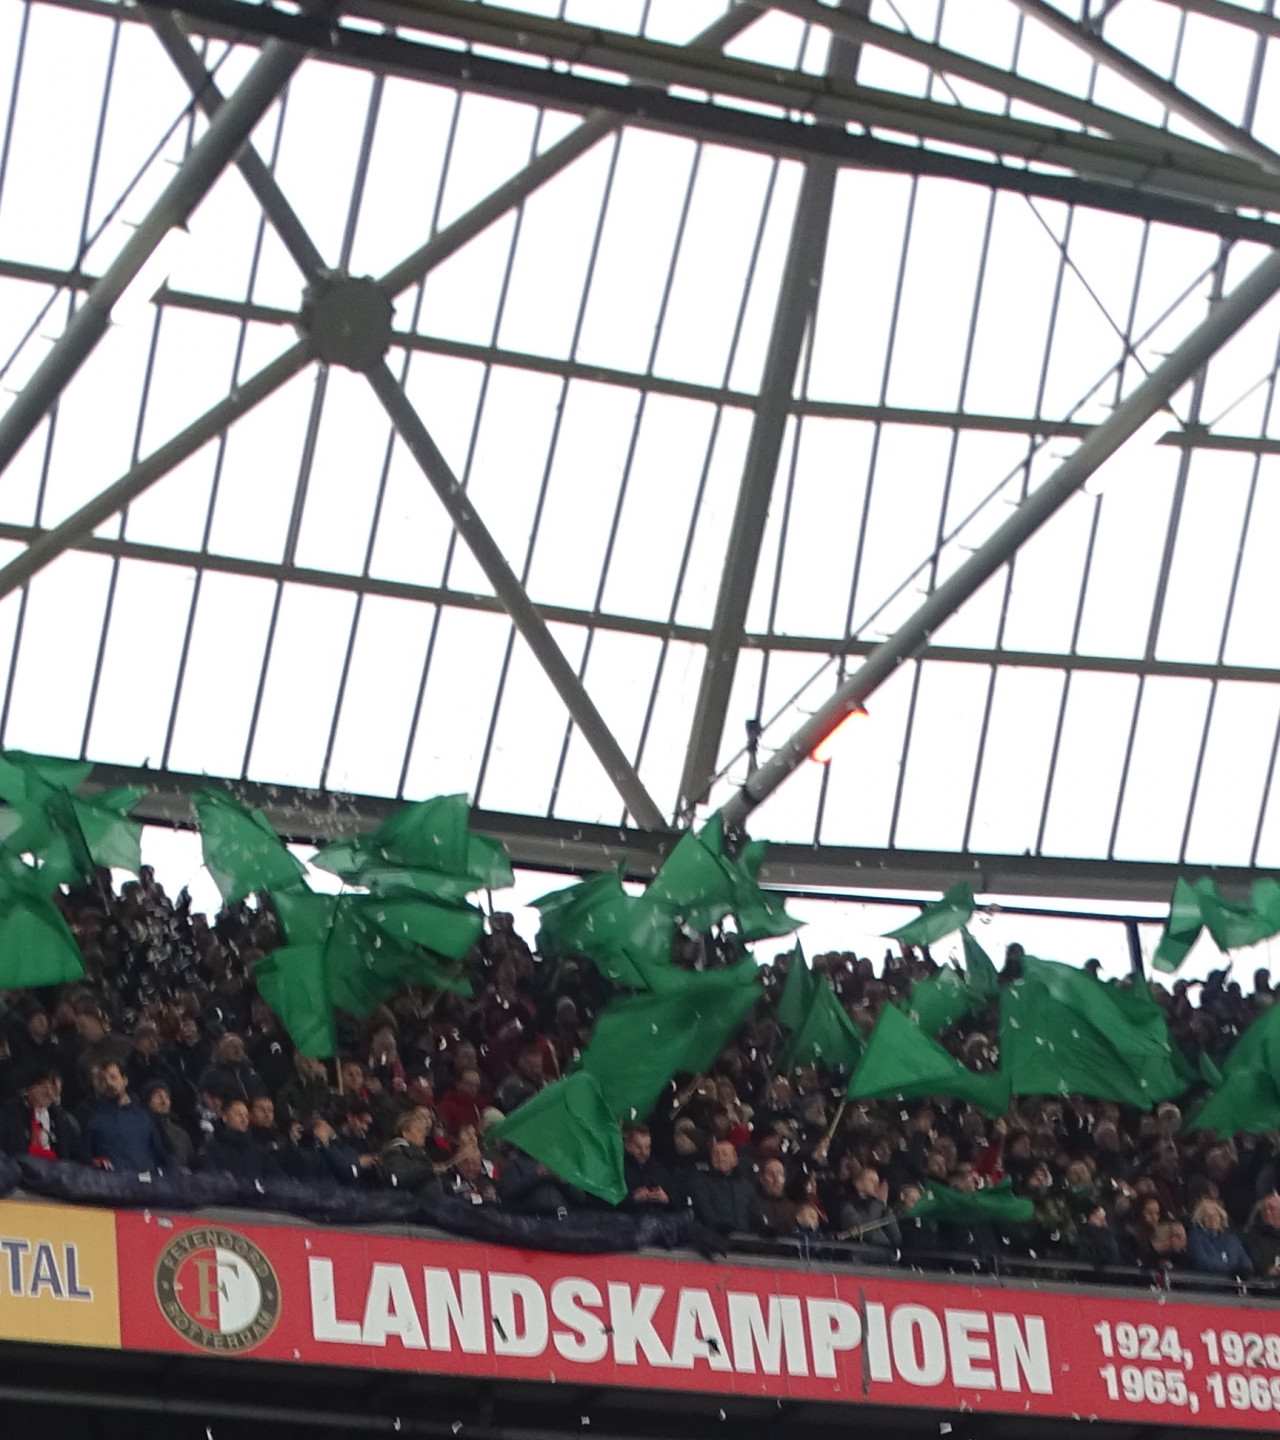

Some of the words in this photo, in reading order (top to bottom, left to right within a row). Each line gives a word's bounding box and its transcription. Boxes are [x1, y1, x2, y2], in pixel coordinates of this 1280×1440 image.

[308, 1255, 1054, 1395] LANDSKAMPIOEN
[1093, 1320, 1194, 1371] 1924,
[1099, 1363, 1200, 1414] 1965,
